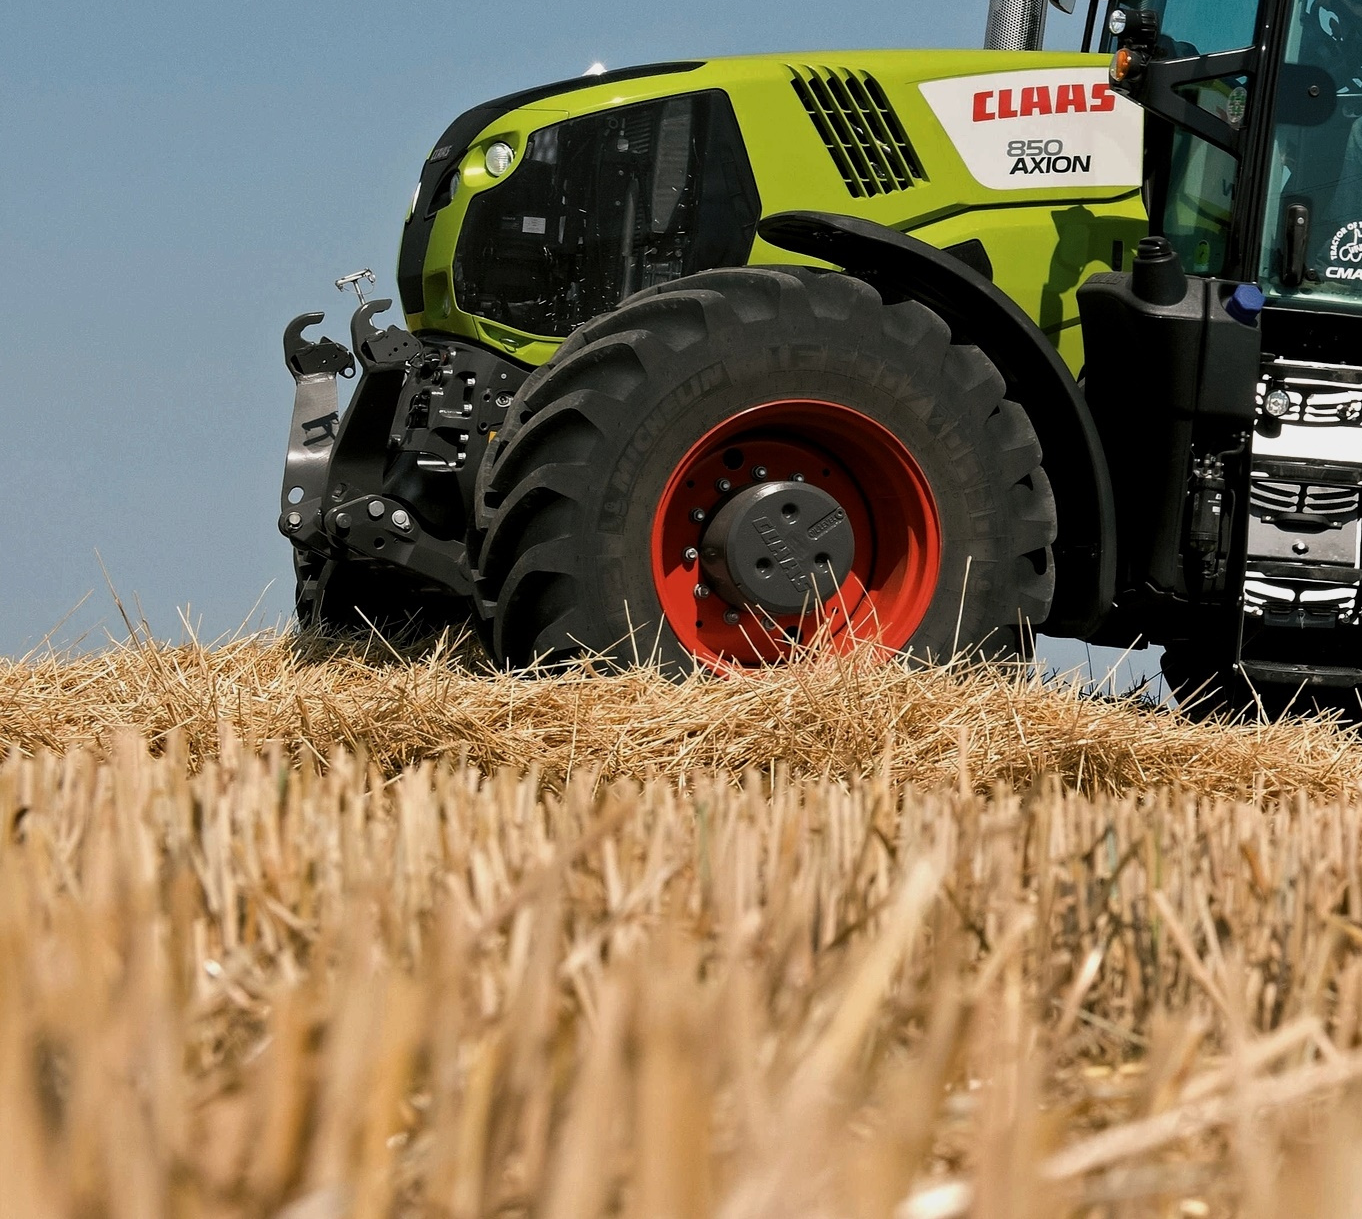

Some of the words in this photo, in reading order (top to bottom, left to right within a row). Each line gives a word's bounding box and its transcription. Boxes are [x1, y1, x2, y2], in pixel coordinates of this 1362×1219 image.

[973, 83, 1116, 122] CLAAS
[1007, 139, 1063, 157] 850
[1009, 155, 1092, 175] AXION
[1330, 227, 1348, 261] TRACTOR
[1347, 221, 1358, 231] OF
[752, 516, 813, 593] CLAAS
